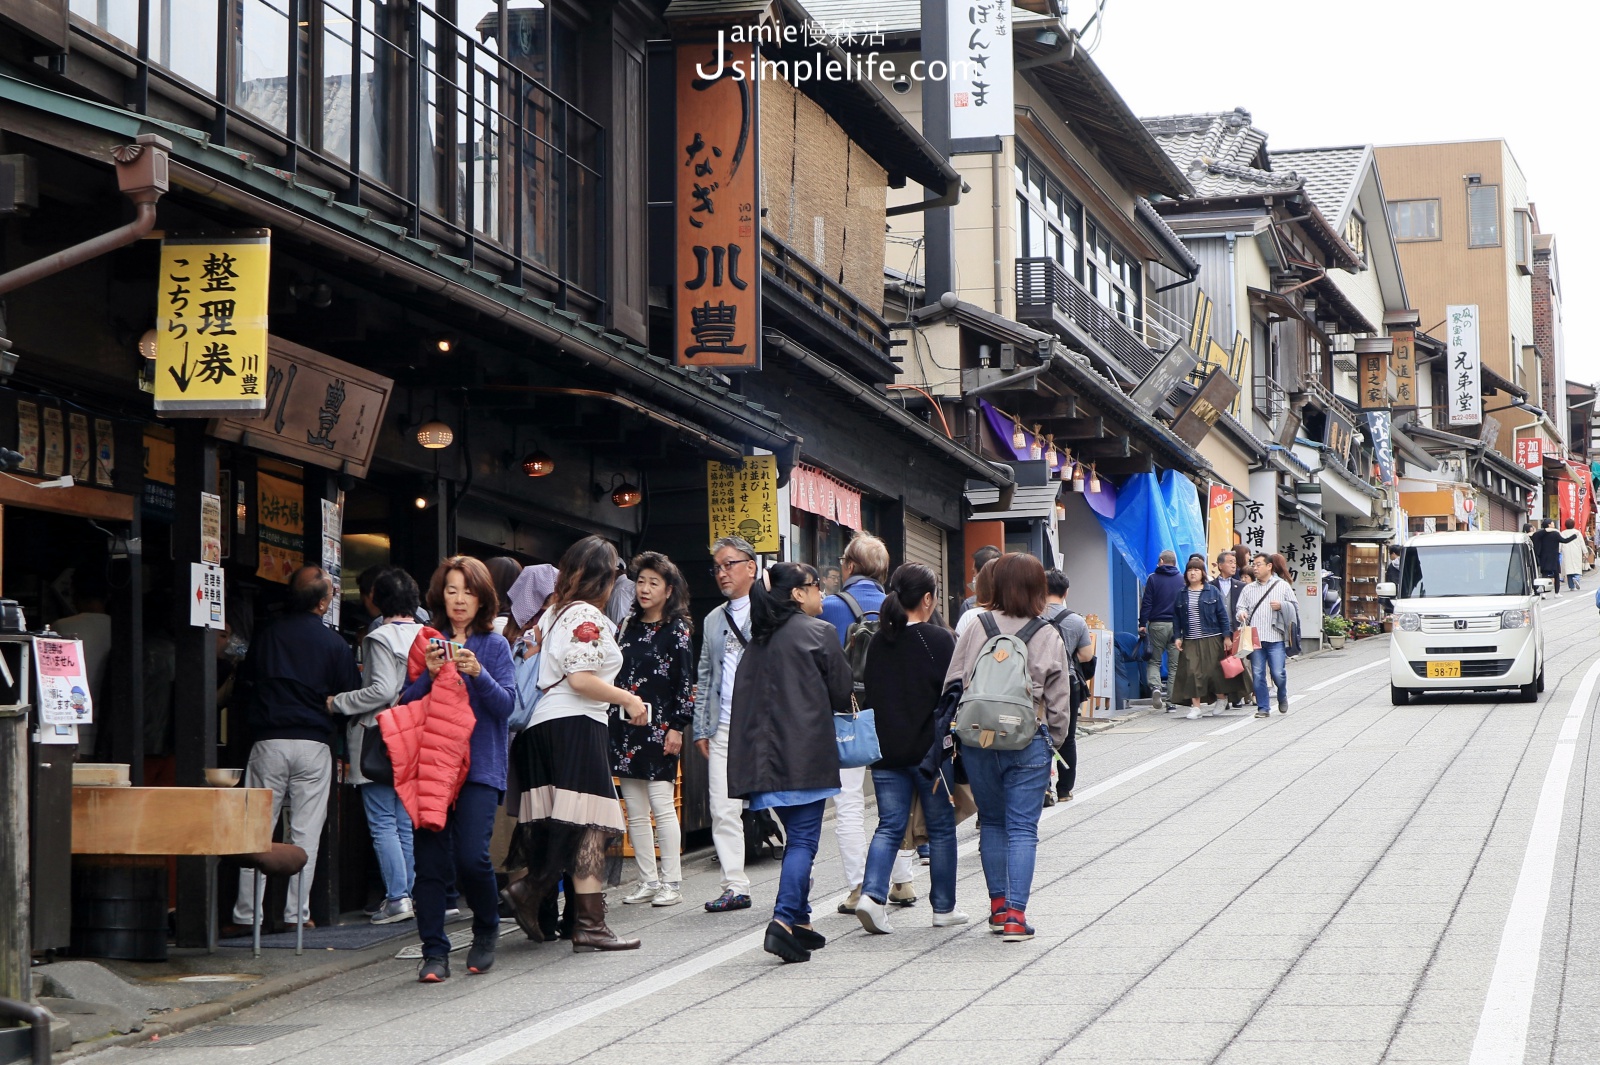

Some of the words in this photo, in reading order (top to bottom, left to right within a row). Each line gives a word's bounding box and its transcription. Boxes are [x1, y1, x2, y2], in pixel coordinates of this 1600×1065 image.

[168, 258, 191, 340] こちら
[195, 253, 239, 385] 整理券
[240, 354, 259, 395] 川豊
[1454, 351, 1474, 412] 兄弟堂
[750, 460, 759, 491] お並び
[1527, 440, 1539, 464] 加藤
[761, 460, 772, 538] これより先には、
[1300, 530, 1318, 571] 京増
